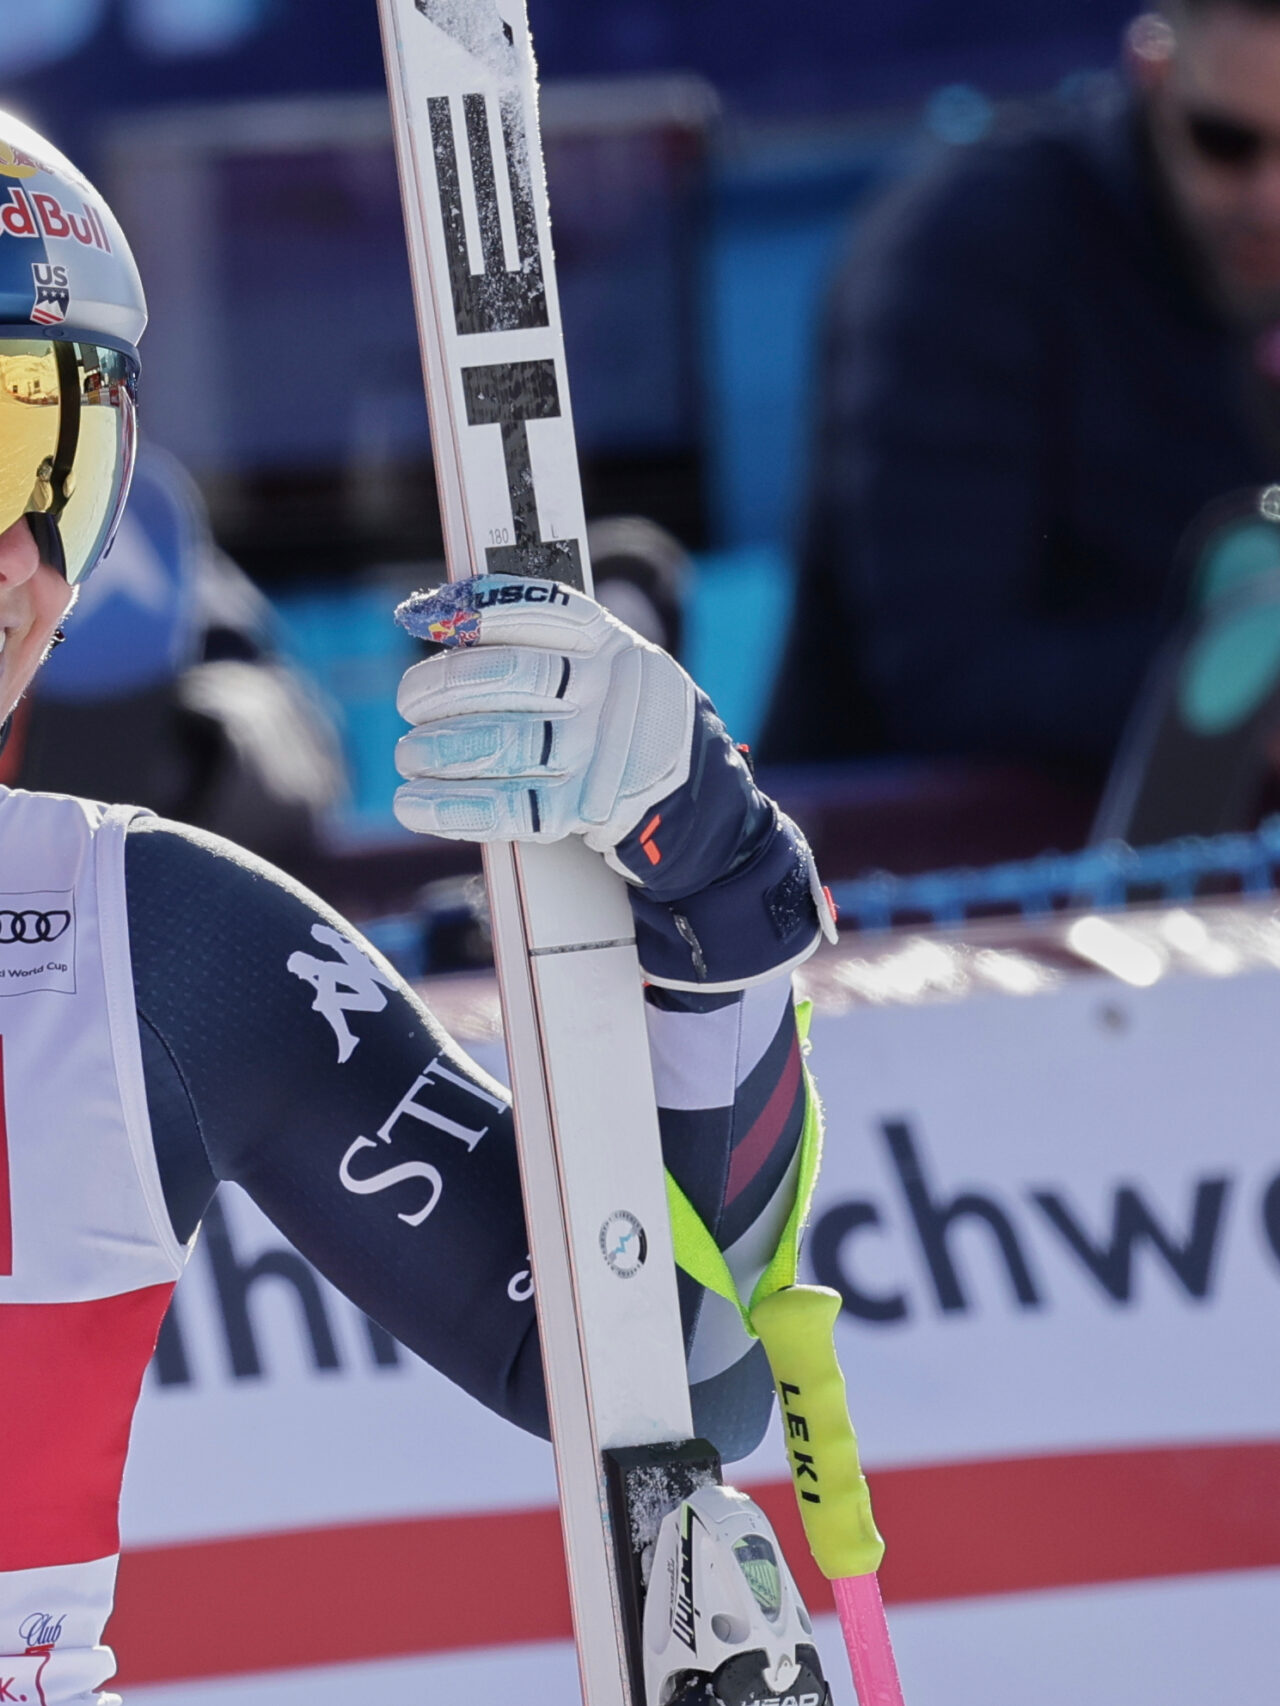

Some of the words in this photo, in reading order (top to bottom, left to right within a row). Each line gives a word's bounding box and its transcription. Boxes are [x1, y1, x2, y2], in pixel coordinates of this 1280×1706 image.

[30, 192, 111, 254] Bull
[33, 264, 68, 286] US
[489, 526, 510, 545] 180
[474, 582, 570, 610] usch
[8, 965, 44, 977] World
[47, 962, 68, 972] Cup
[779, 1379, 821, 1504] LEKI
[19, 1612, 67, 1647] Club
